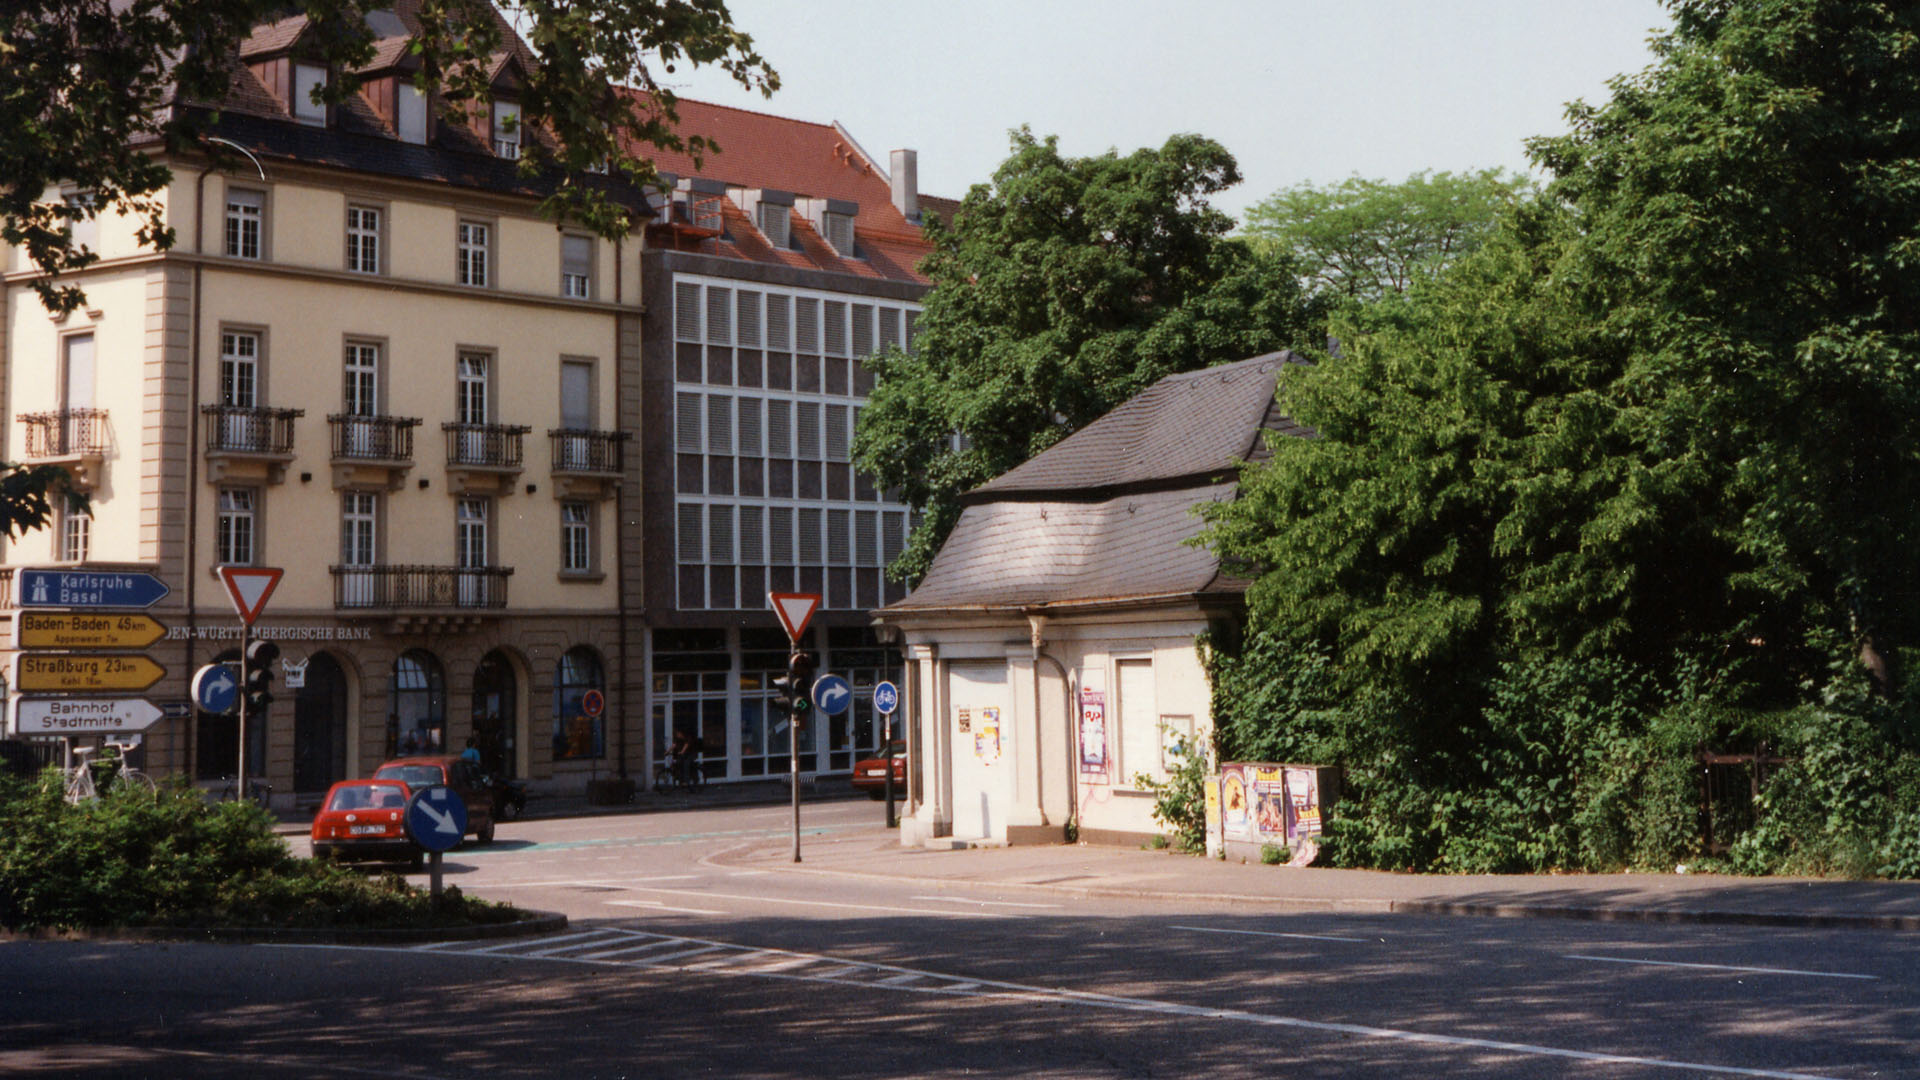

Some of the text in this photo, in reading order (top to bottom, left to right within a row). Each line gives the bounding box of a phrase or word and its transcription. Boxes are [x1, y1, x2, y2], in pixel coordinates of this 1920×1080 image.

[60, 574, 133, 588] Karlsruhe
[60, 589, 103, 603] Basel
[25, 616, 110, 631] Baden-Baden
[337, 627, 371, 640] BANK
[26, 658, 98, 676] Straßburg
[61, 677, 80, 686] Kehl
[50, 702, 115, 715] Bahnhof
[42, 715, 123, 728] Stadtmitte
